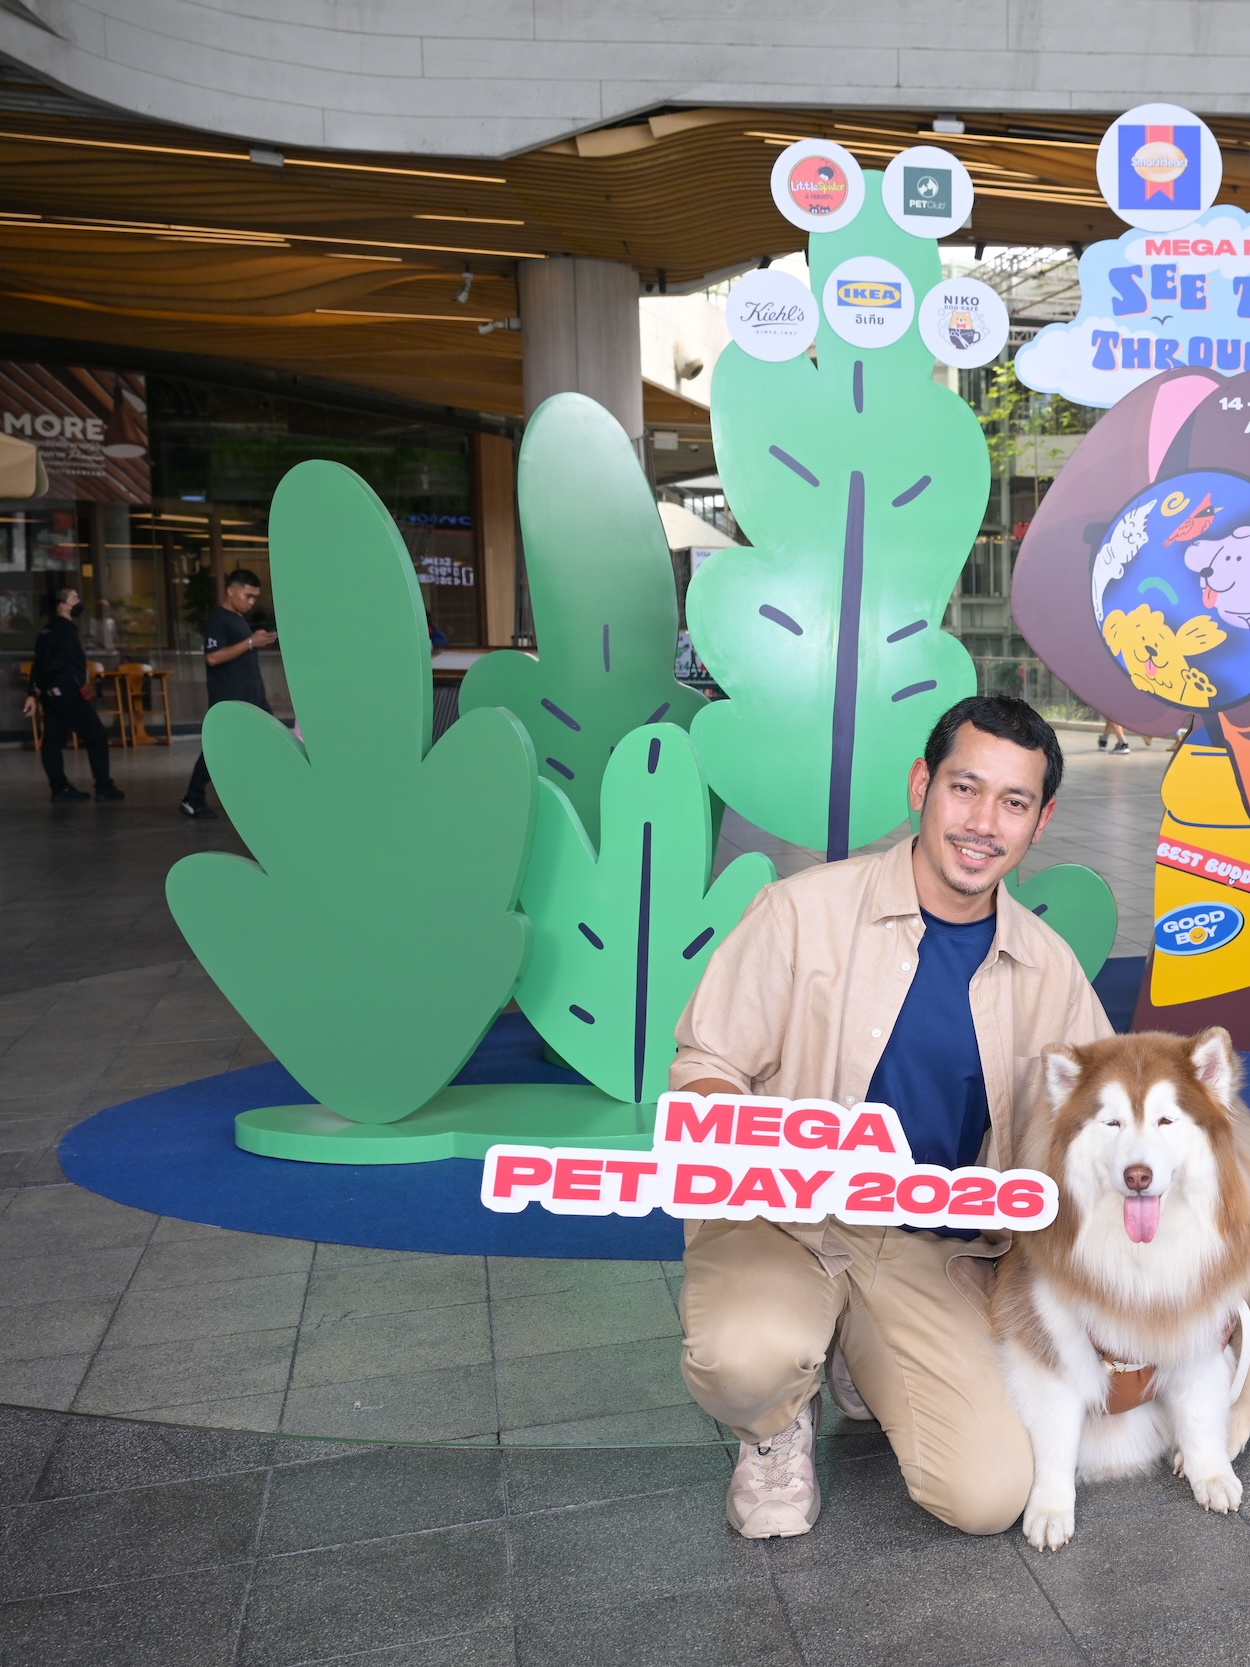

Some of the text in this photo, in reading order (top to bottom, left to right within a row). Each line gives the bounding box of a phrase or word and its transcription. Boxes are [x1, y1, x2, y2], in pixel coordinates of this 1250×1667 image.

[1131, 157, 1189, 168] SmartHeart
[1145, 239, 1238, 256] MEGA
[843, 287, 897, 301] IKEA
[944, 295, 980, 306] NIKO
[1108, 264, 1209, 317] SEE
[740, 301, 805, 322] Kiehl's
[855, 313, 885, 325] อิเกีย
[1219, 397, 1244, 411] 14
[3, 412, 105, 441] MORE
[1156, 842, 1204, 867] BEST
[1163, 910, 1226, 933] GOOD
[664, 1101, 897, 1154] MEGA
[492, 1155, 1046, 1218] PET DAY 2026
